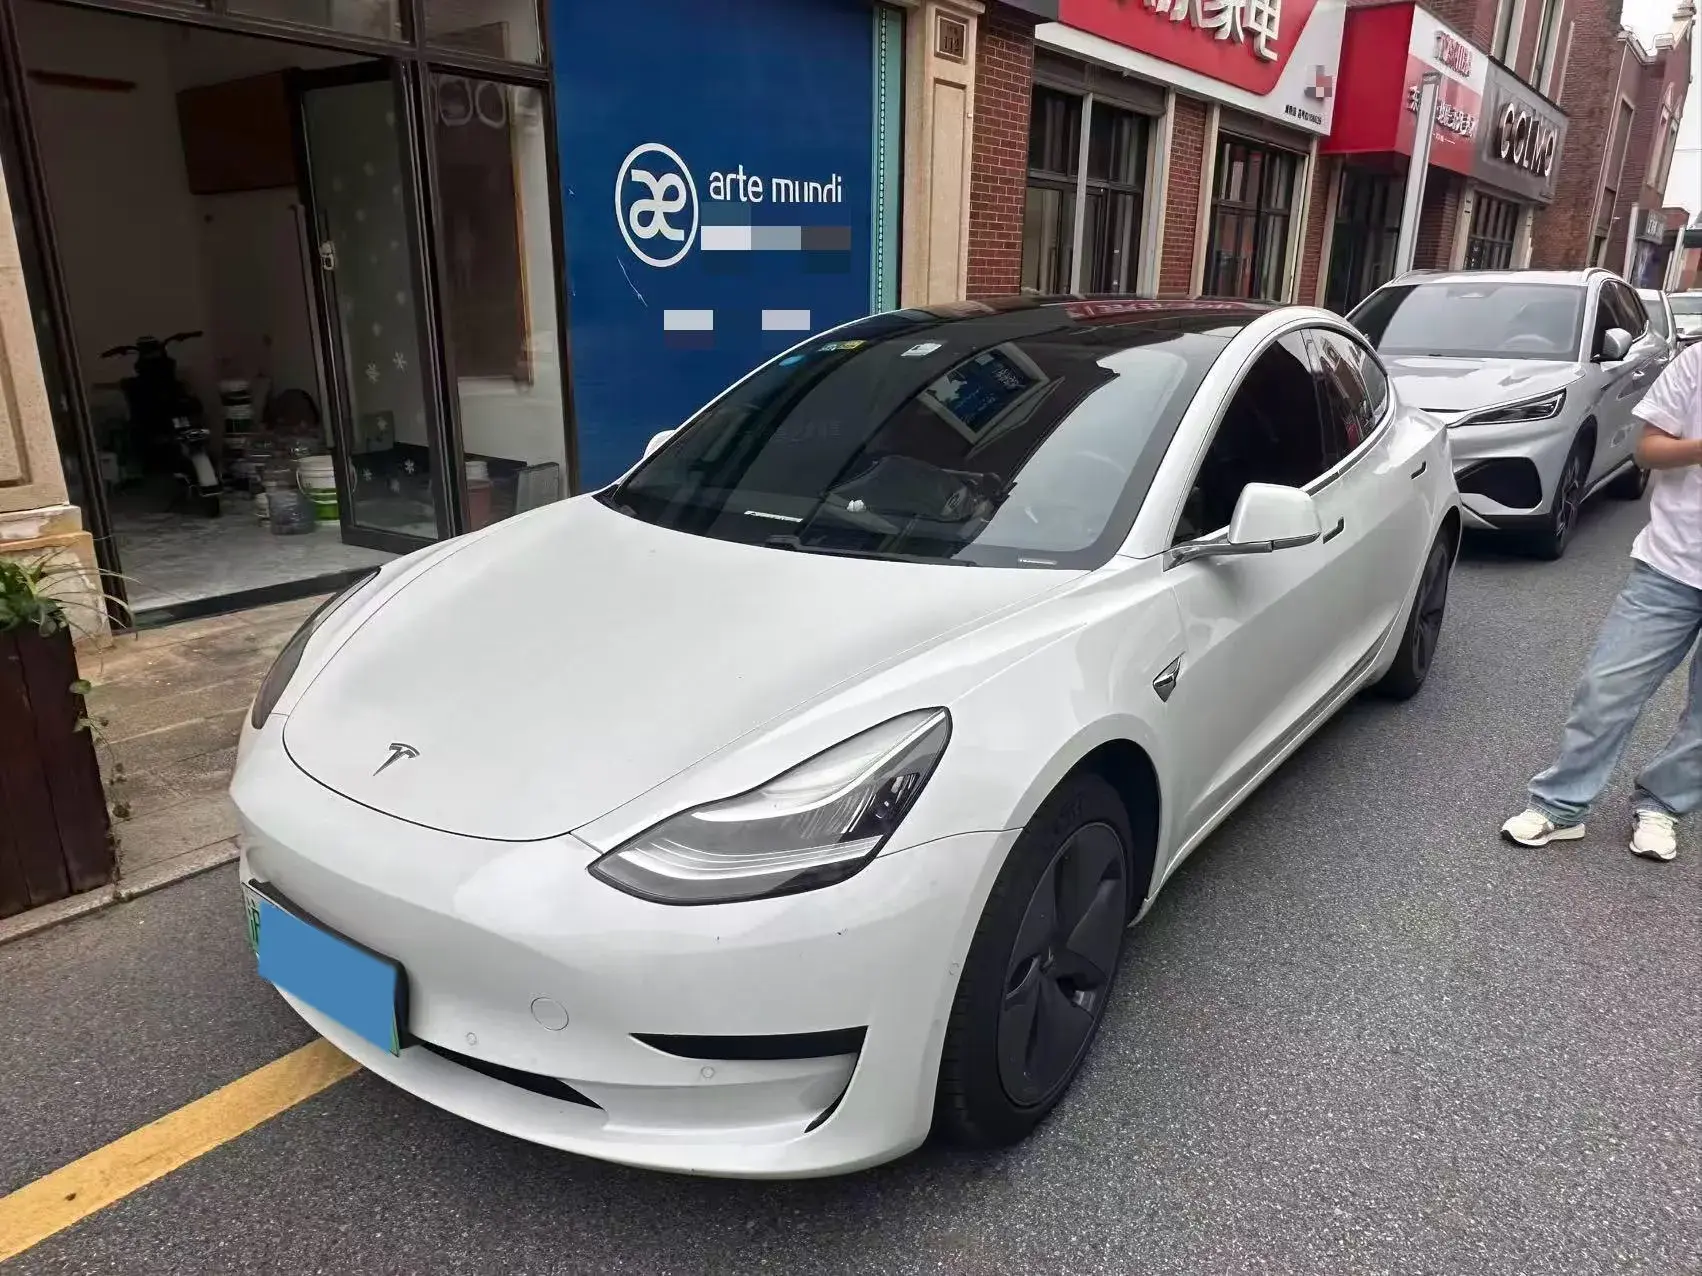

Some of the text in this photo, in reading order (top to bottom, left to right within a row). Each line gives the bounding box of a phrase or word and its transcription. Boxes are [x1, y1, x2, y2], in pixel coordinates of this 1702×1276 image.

[1500, 102, 1556, 177] COLMO
[709, 164, 842, 203] arte mundi
